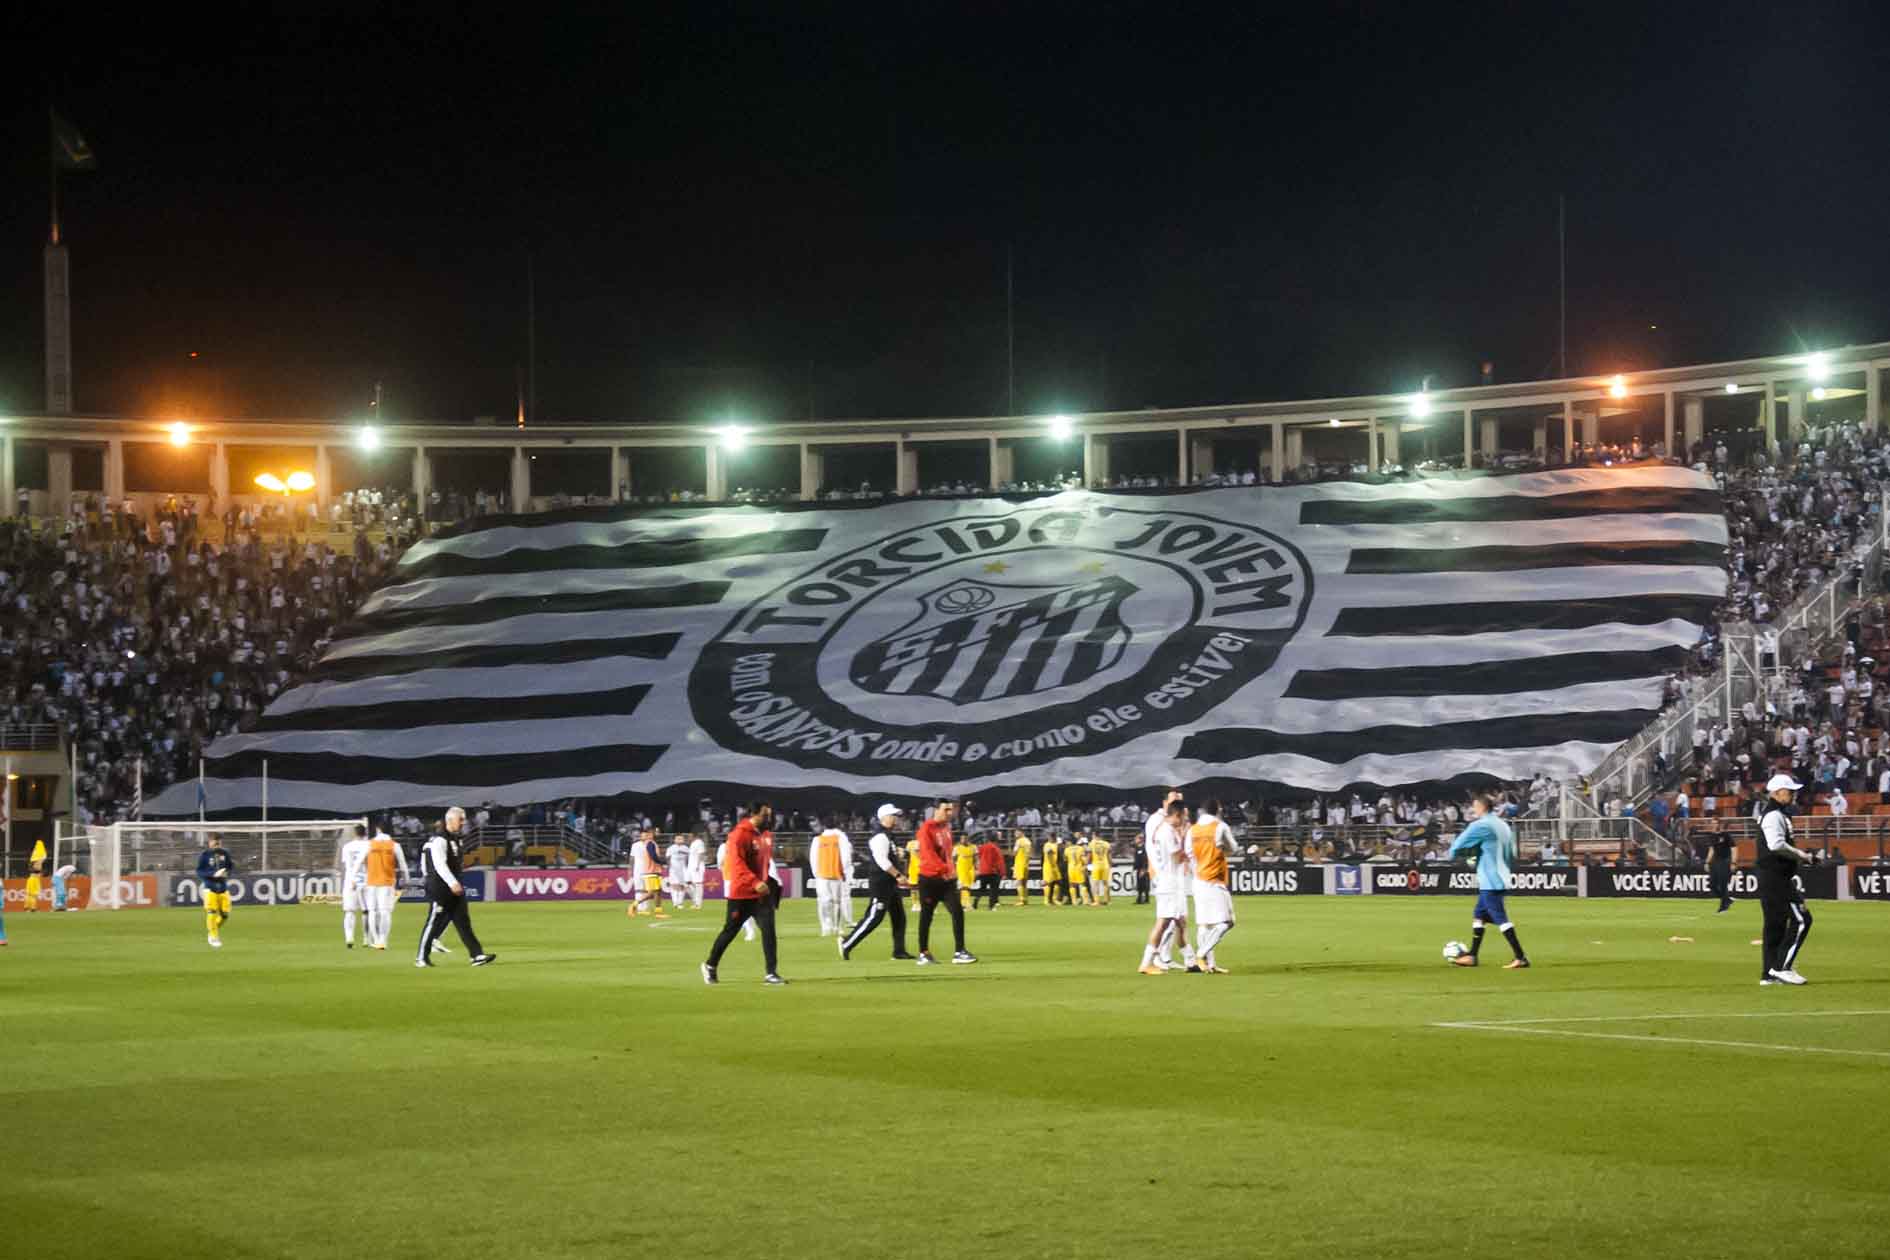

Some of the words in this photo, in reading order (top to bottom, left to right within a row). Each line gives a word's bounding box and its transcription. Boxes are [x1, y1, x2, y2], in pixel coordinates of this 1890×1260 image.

[744, 512, 1085, 633] TORCIDA
[1114, 519, 1294, 617] JOVEM
[730, 653, 775, 690] com
[1144, 632, 1254, 709] estiver
[729, 696, 882, 759] SANTOS
[1086, 703, 1142, 732] ele
[871, 734, 959, 761] onde
[962, 743, 988, 761] e
[990, 724, 1085, 760] como
[1231, 871, 1298, 892] IGUAIS
[1612, 871, 1650, 891] VOCÊ
[1653, 871, 1671, 891] VÊ
[1673, 874, 1711, 891] ANTE
[1859, 871, 1880, 893] VÊ
